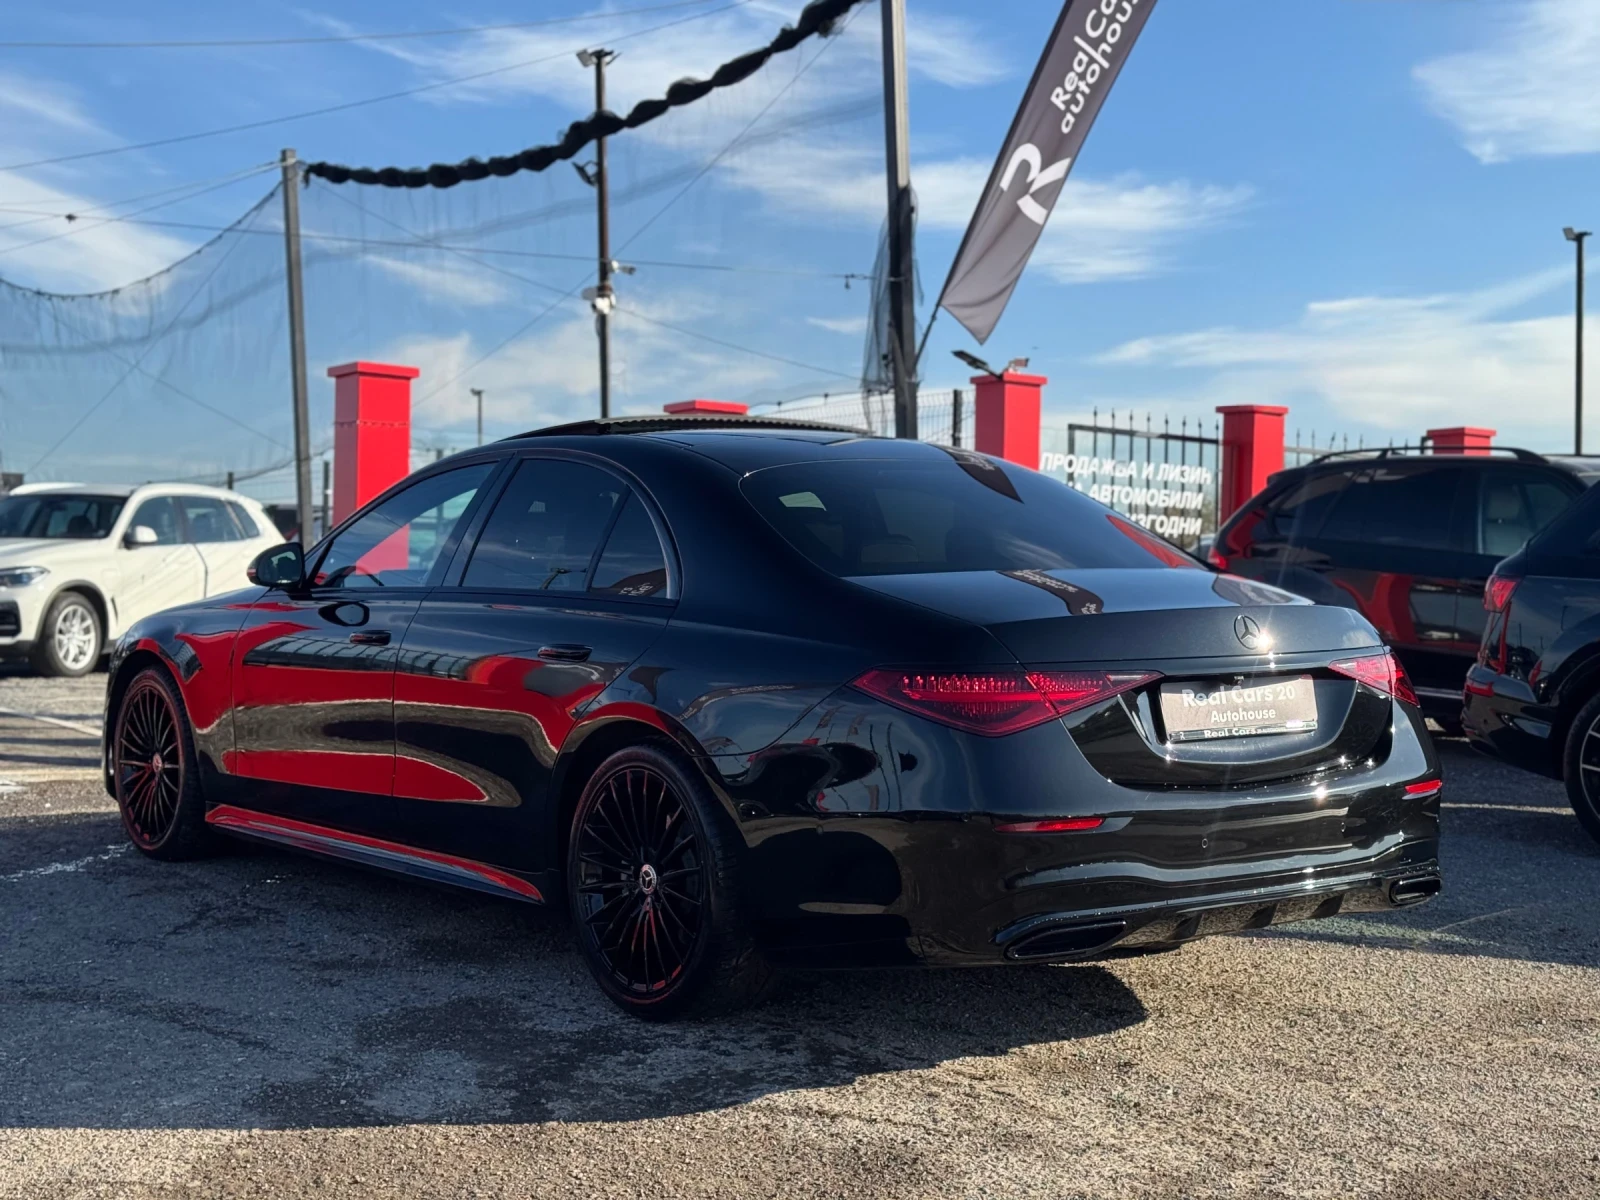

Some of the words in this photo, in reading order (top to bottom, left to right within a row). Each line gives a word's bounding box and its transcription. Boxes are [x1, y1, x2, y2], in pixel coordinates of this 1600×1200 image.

[1050, 35, 1110, 111] Real
[1141, 461, 1155, 481] И
[1088, 483, 1204, 510] АВТОМОБИЛИ
[1181, 685, 1227, 708] Real
[1231, 684, 1274, 704] Cars
[1276, 684, 1296, 700] 20
[1210, 706, 1277, 723] Autohouse
[1203, 728, 1229, 739] Real
[1231, 728, 1257, 736] Cars
